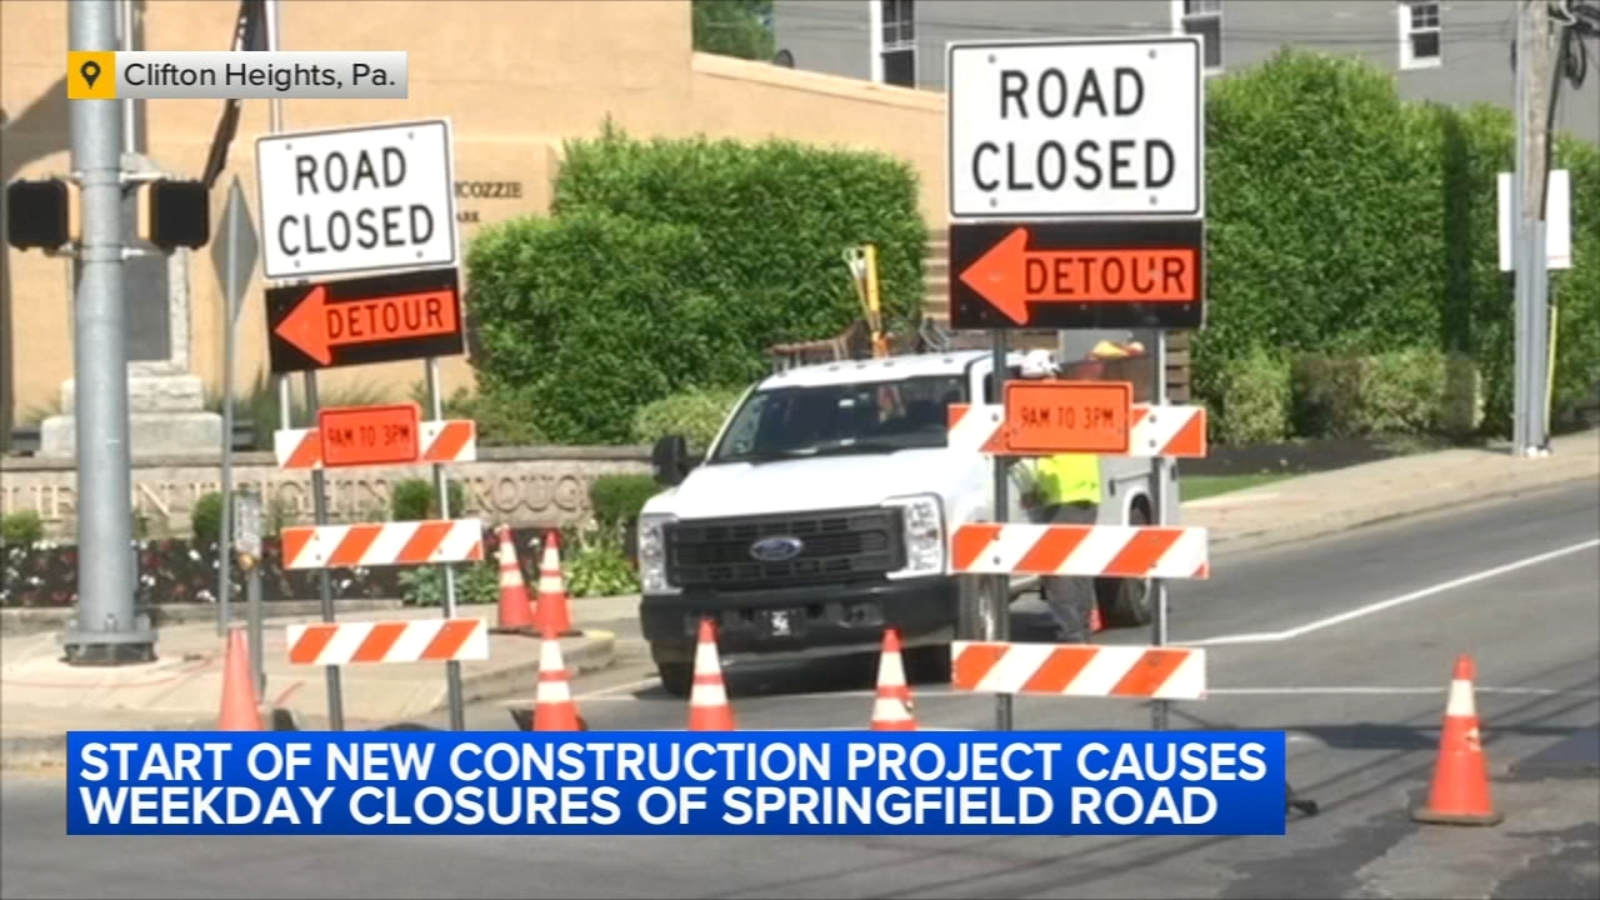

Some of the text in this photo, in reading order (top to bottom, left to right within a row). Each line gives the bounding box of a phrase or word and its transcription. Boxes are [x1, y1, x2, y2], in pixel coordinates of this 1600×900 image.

[1000, 67, 1144, 119] ROAD
[296, 147, 406, 195] ROAD
[972, 139, 1176, 192] CLOSED
[278, 204, 434, 256] CLOSED
[1025, 256, 1187, 296] DETOUR
[326, 298, 444, 340] DETOUR
[1020, 405, 1115, 430] 9AM TO 3PM
